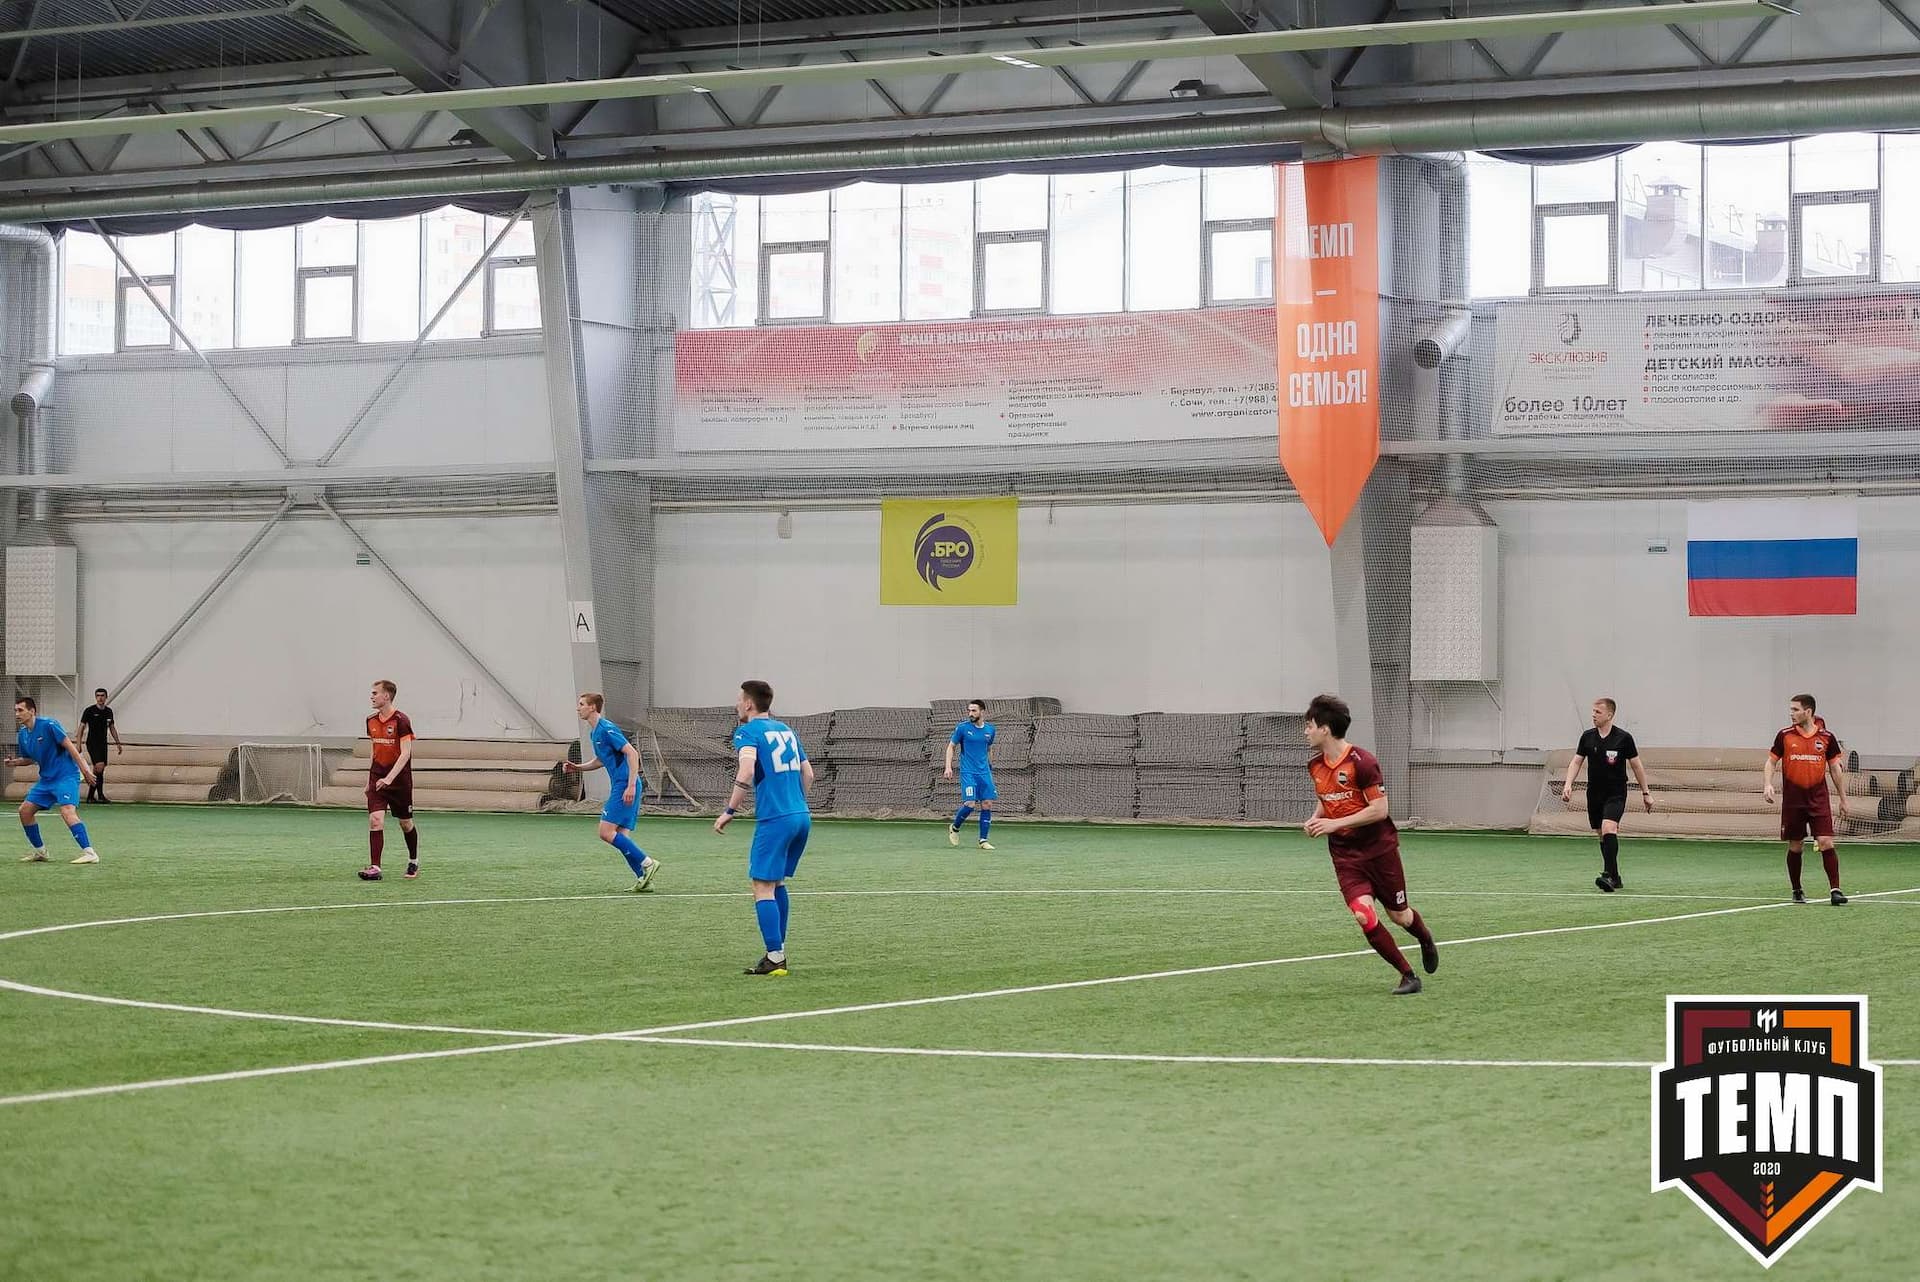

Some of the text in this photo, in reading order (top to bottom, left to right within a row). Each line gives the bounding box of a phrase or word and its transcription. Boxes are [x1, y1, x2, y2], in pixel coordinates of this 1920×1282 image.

[1305, 222, 1354, 259] ЕМП
[900, 332, 933, 345] ВАШ
[1296, 320, 1358, 362] ОДНА
[1528, 351, 1609, 364] ЭКСКЛЮЗИВ
[1645, 354, 1723, 373] ДЕТСКИЙ
[1289, 369, 1367, 407] СЕМЬЯ!
[1191, 407, 1279, 418] www.organizator-
[1505, 395, 1628, 413] более 10лет
